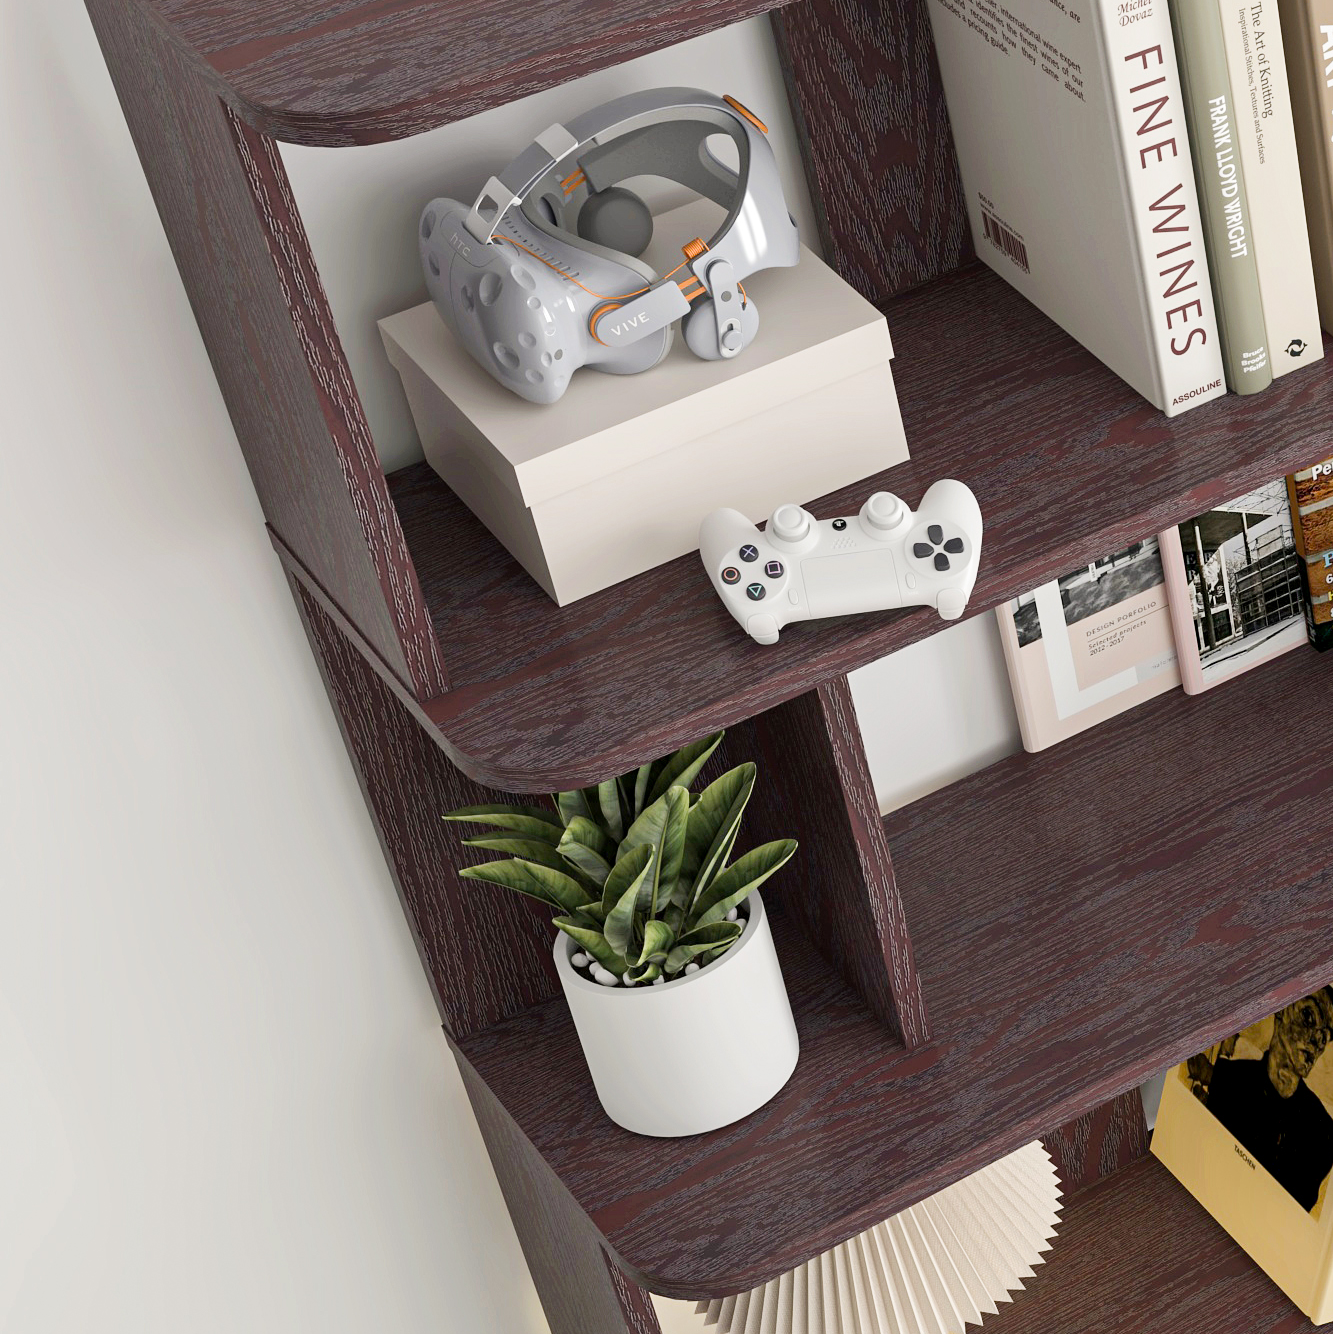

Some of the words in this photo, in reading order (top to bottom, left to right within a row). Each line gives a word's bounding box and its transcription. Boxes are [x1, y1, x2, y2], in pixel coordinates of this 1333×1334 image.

[1119, 7, 1153, 27] Dovaz
[1238, 8, 1252, 54] Inspirational
[1124, 44, 1177, 169] FINE
[1259, 66, 1274, 119] Knitting
[1208, 95, 1232, 146] FRANK
[1215, 147, 1240, 199] LLOYD
[1224, 199, 1248, 259] WRIGHT
[1148, 183, 1207, 356] WINES
[610, 311, 650, 338] VIVE
[1172, 379, 1222, 406] ASSOULINE
[1086, 620, 1115, 637] DESIGN
[1117, 601, 1157, 623] PORFOLIO
[1088, 632, 1118, 650] Selected
[1119, 620, 1147, 636] projects
